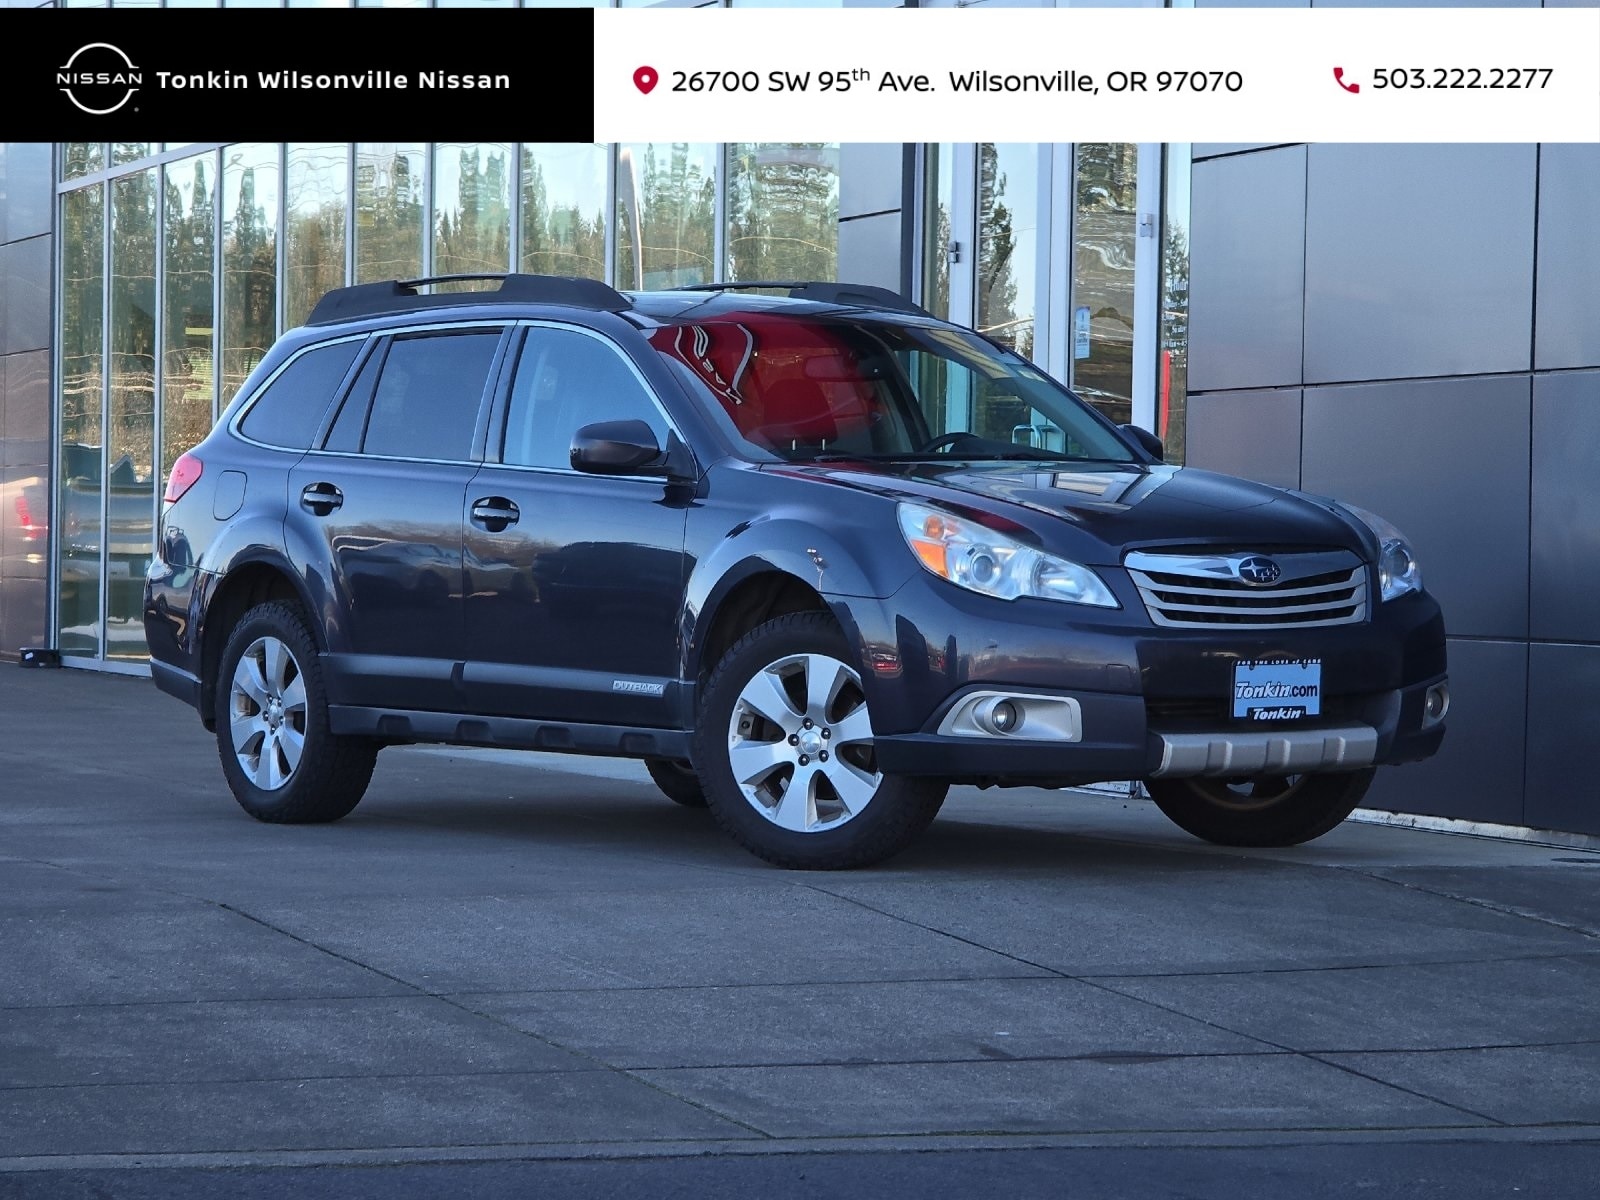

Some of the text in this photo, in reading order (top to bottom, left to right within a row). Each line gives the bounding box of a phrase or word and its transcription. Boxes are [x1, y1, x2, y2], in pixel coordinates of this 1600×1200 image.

[613, 680, 663, 695] OUTBACK
[1235, 681, 1318, 699] Tonkin.com
[1252, 707, 1303, 720] Tonkin
